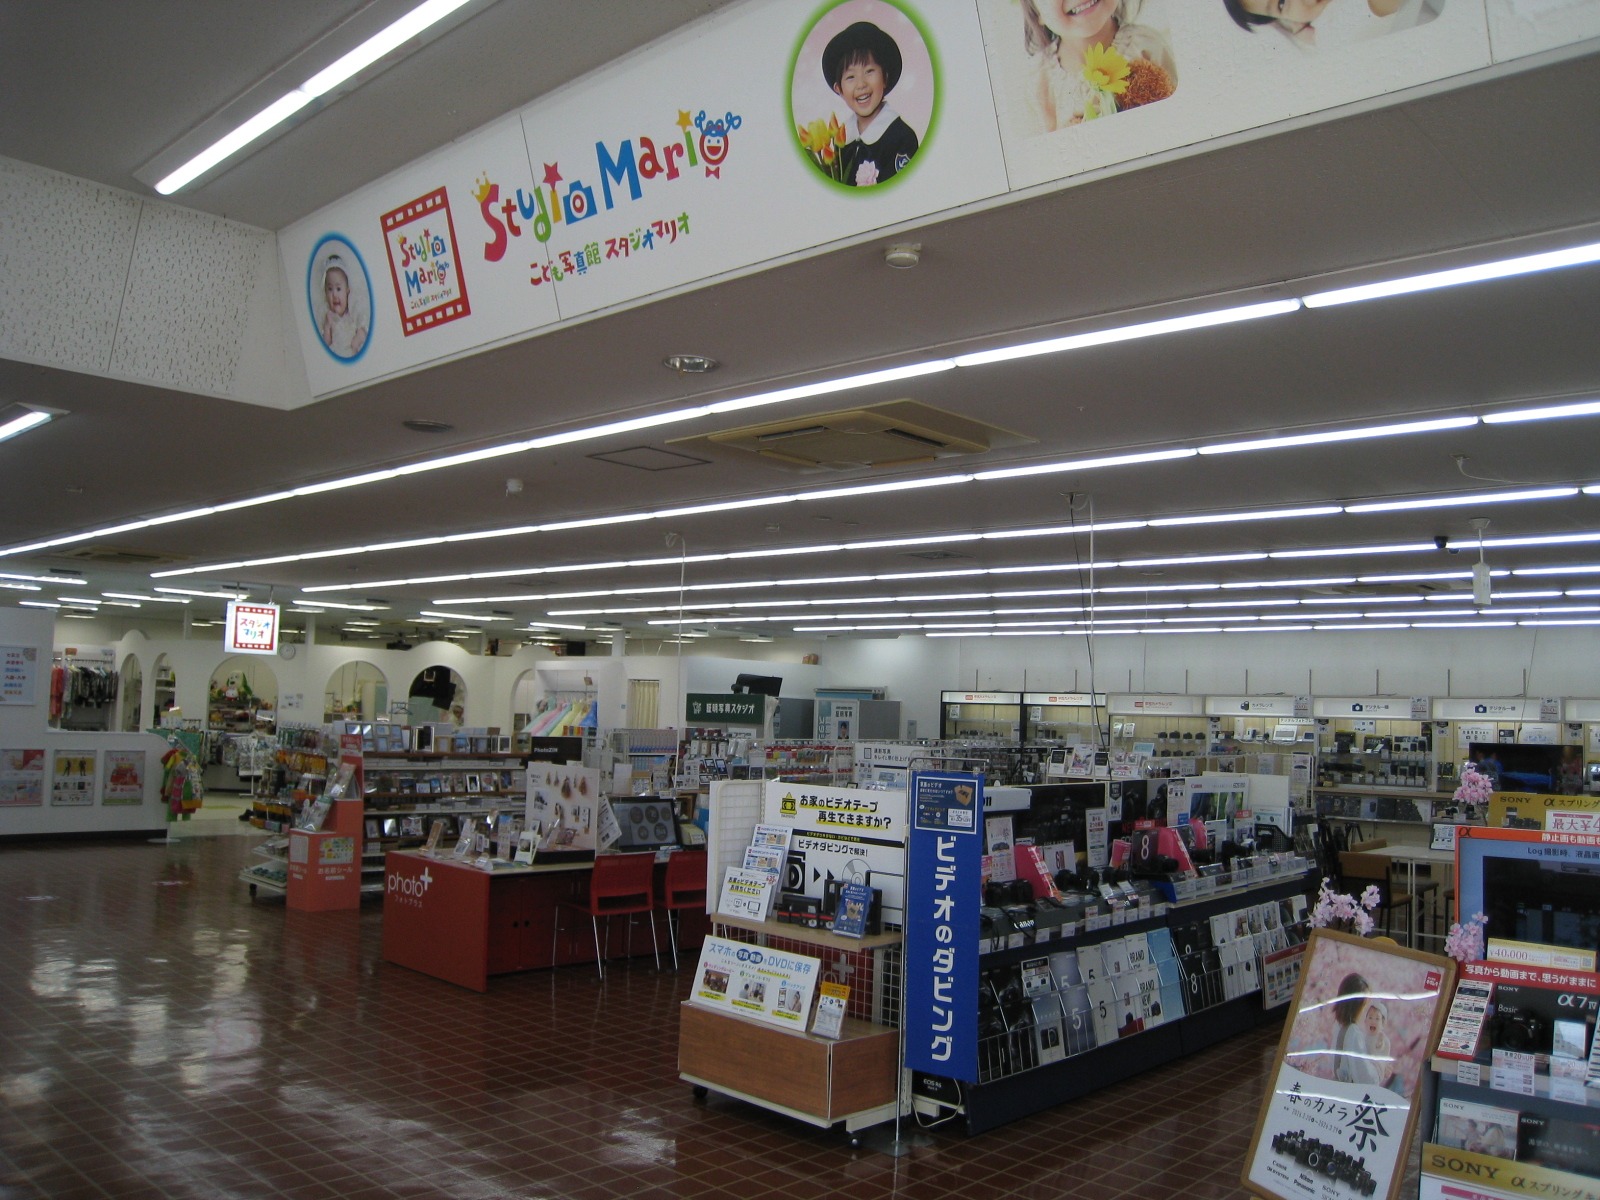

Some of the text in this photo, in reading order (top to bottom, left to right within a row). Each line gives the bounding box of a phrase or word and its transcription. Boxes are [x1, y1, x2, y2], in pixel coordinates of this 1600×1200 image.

[474, 109, 742, 262] Studio Mario
[398, 229, 447, 268] Studio
[530, 211, 690, 286] こども写真館 スタジオマリオ
[404, 260, 450, 298] Mario
[240, 617, 271, 629] スタジオ
[243, 628, 265, 640] マリオ
[706, 703, 755, 714] 証明写真スタジオ
[800, 795, 878, 813] お家のビデオテープ
[1500, 796, 1531, 804] SONY
[818, 810, 891, 829] 再生できますか?
[1141, 834, 1149, 860] 8
[930, 835, 957, 1062] ビデオのダビング
[1465, 964, 1597, 988] 写真から動画まで、思うがままに
[1071, 1007, 1082, 1030] 5
[1099, 1000, 1107, 1019] 5
[1443, 1102, 1465, 1110] SONY
[1520, 1117, 1545, 1126] SONY
[1272, 1159, 1287, 1171] Canon
[1431, 1154, 1499, 1179] SONY
[1293, 1178, 1316, 1194] Panasonic
[1299, 1172, 1314, 1184] Nikon
[1322, 1184, 1340, 1197] SONY
